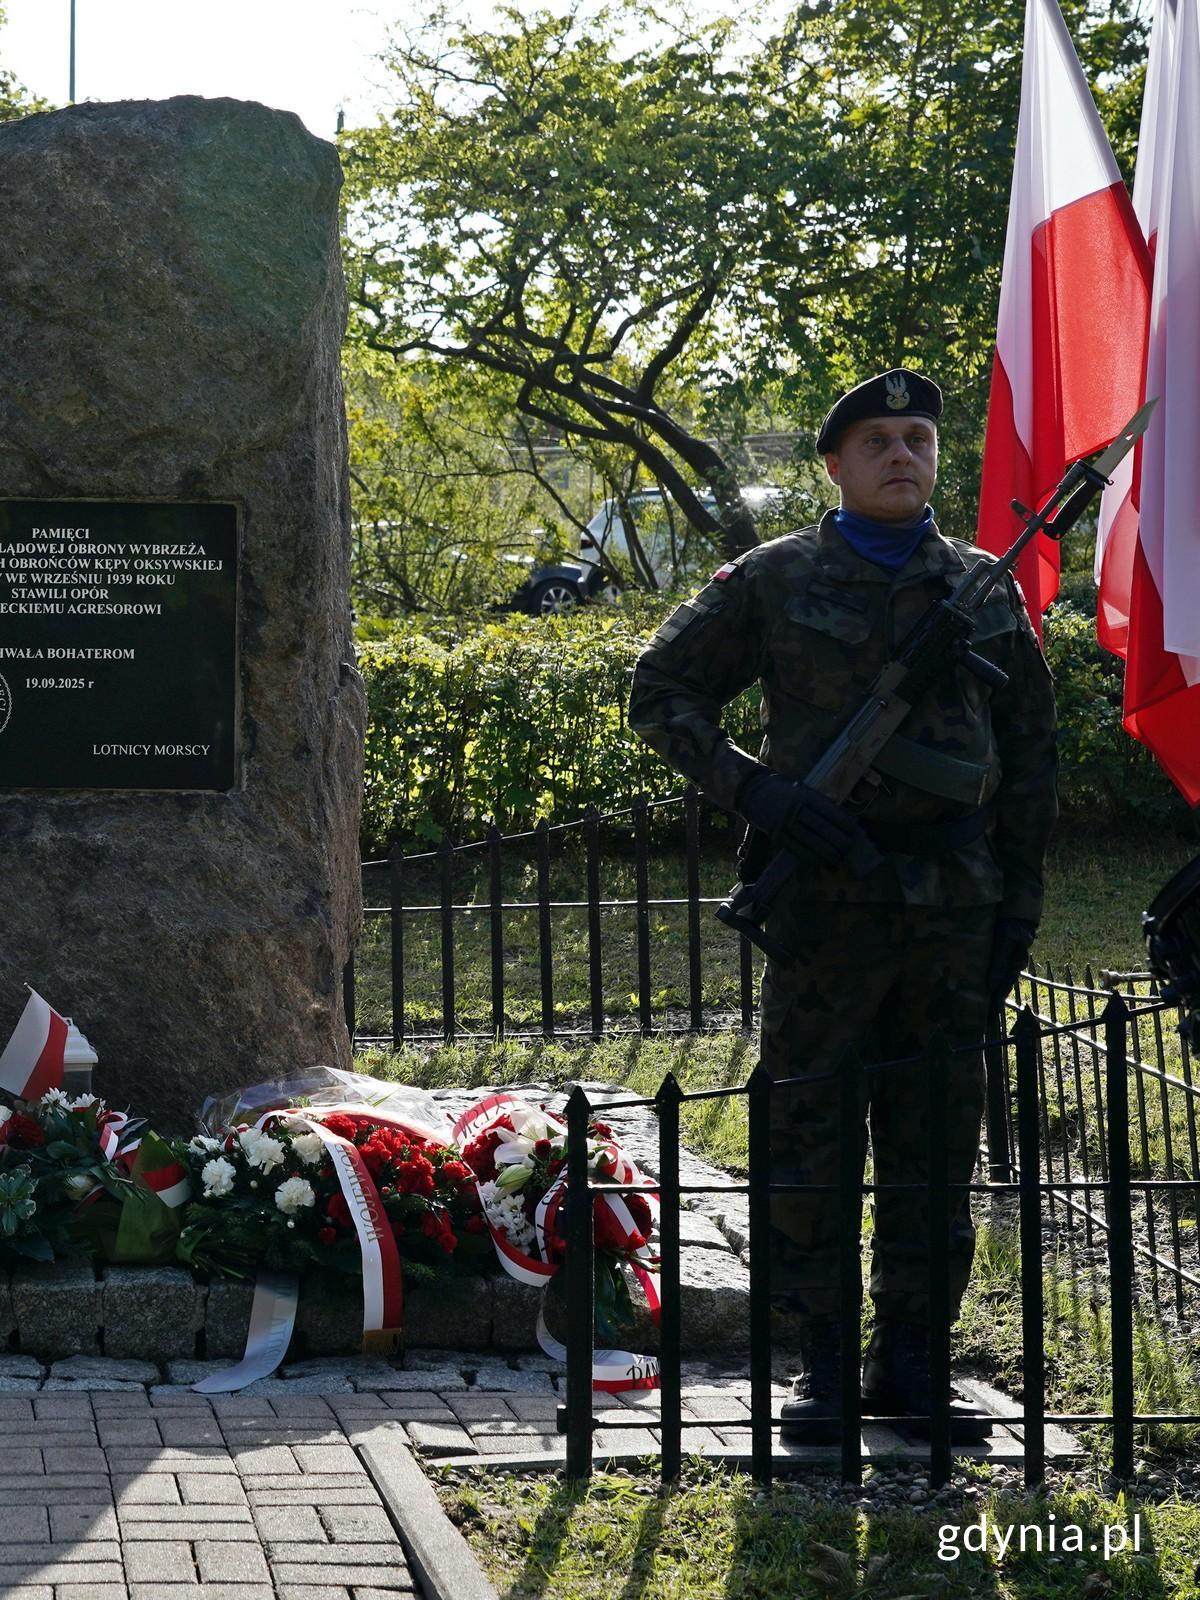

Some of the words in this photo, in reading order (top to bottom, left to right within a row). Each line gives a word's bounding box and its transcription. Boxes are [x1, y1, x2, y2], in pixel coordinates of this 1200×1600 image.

[32, 528, 89, 541] PAMIĘCI
[68, 544, 126, 554] OBRONY
[129, 542, 205, 555] WYBRZEŻA
[9, 555, 91, 569] OBROŃCÓW
[95, 559, 130, 572] KĘPY
[134, 559, 222, 570] OKSYWSKIEJ
[5, 573, 27, 583] WE
[31, 571, 102, 584] WRZEŚNIU
[108, 574, 132, 584] 1939
[137, 574, 175, 585] ROKU
[12, 588, 66, 598] STAWILI
[71, 586, 109, 599] OPÓR
[67, 604, 161, 614] AGRESOROWI
[48, 648, 134, 659] BOHATEROM
[26, 678, 84, 688] 19.09.2025
[94, 745, 151, 755] LOTNICY
[155, 745, 209, 755] MORSCY
